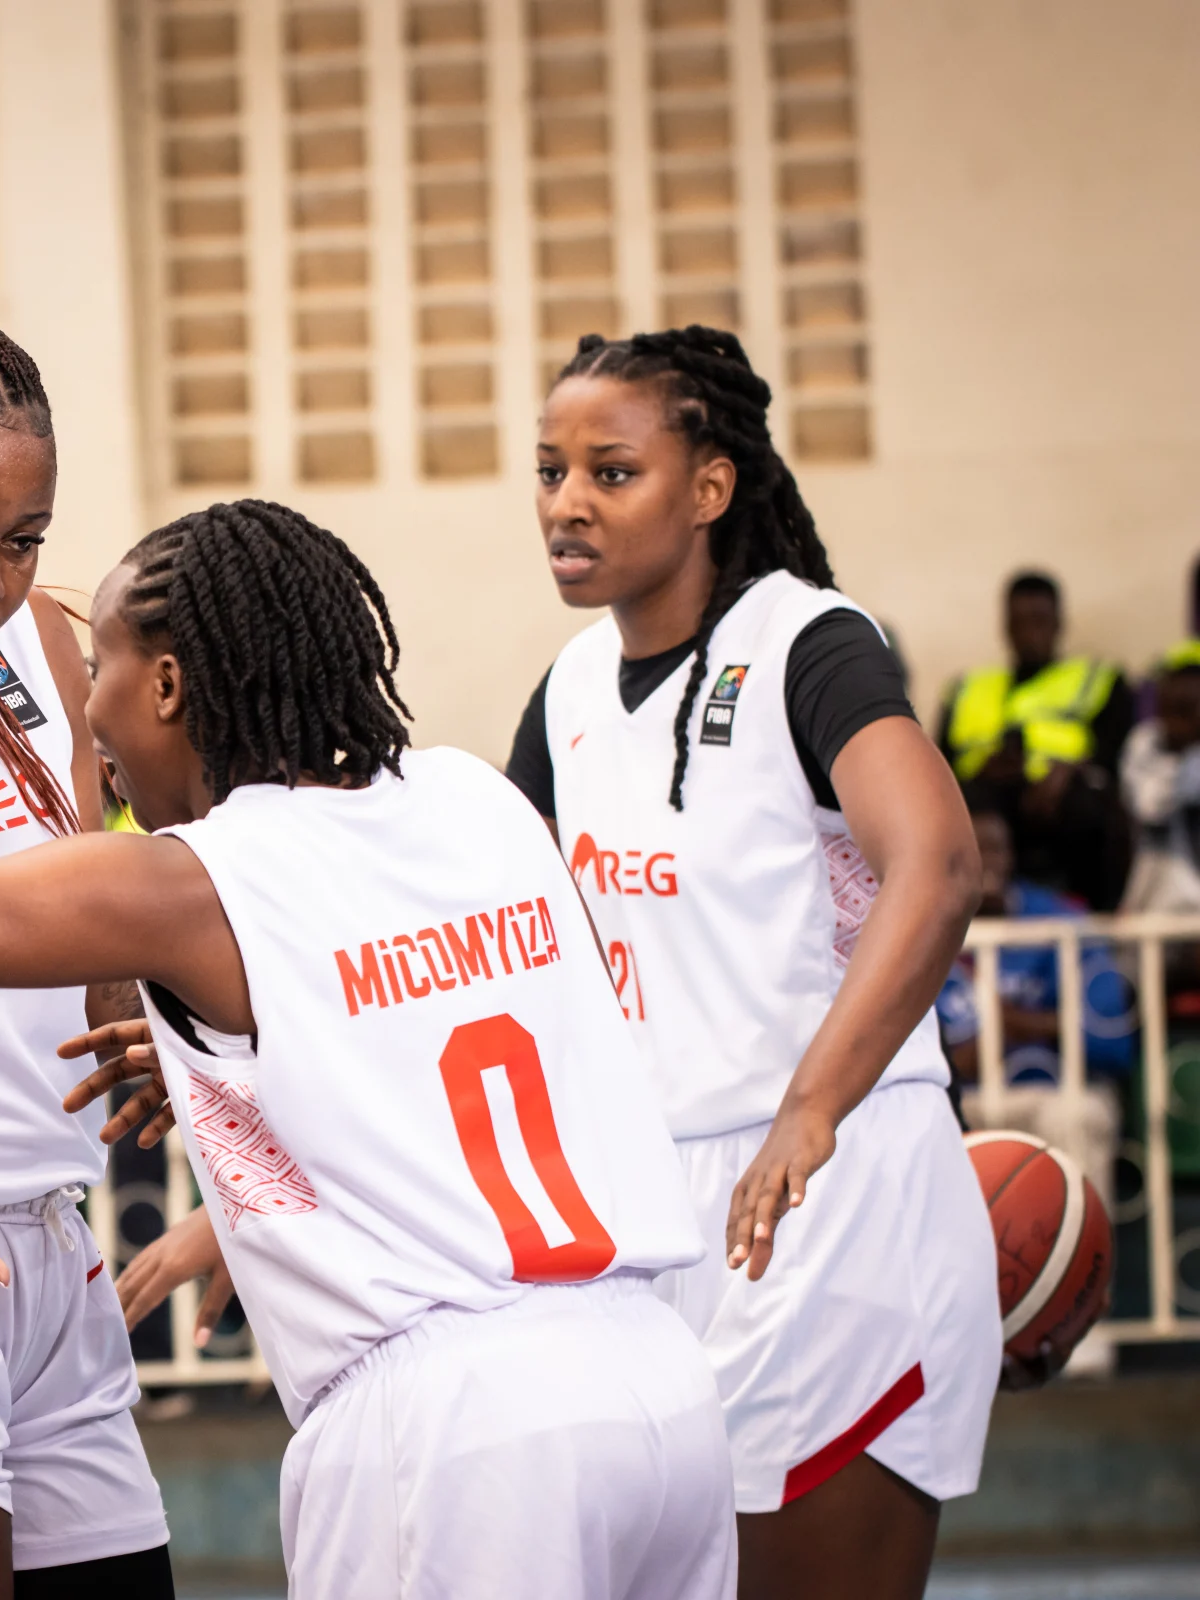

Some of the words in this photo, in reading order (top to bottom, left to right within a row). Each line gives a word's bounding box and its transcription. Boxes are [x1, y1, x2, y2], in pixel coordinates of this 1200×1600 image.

[706, 706, 732, 725] FIBA
[598, 850, 679, 898] REG
[438, 1012, 618, 1285] 0
